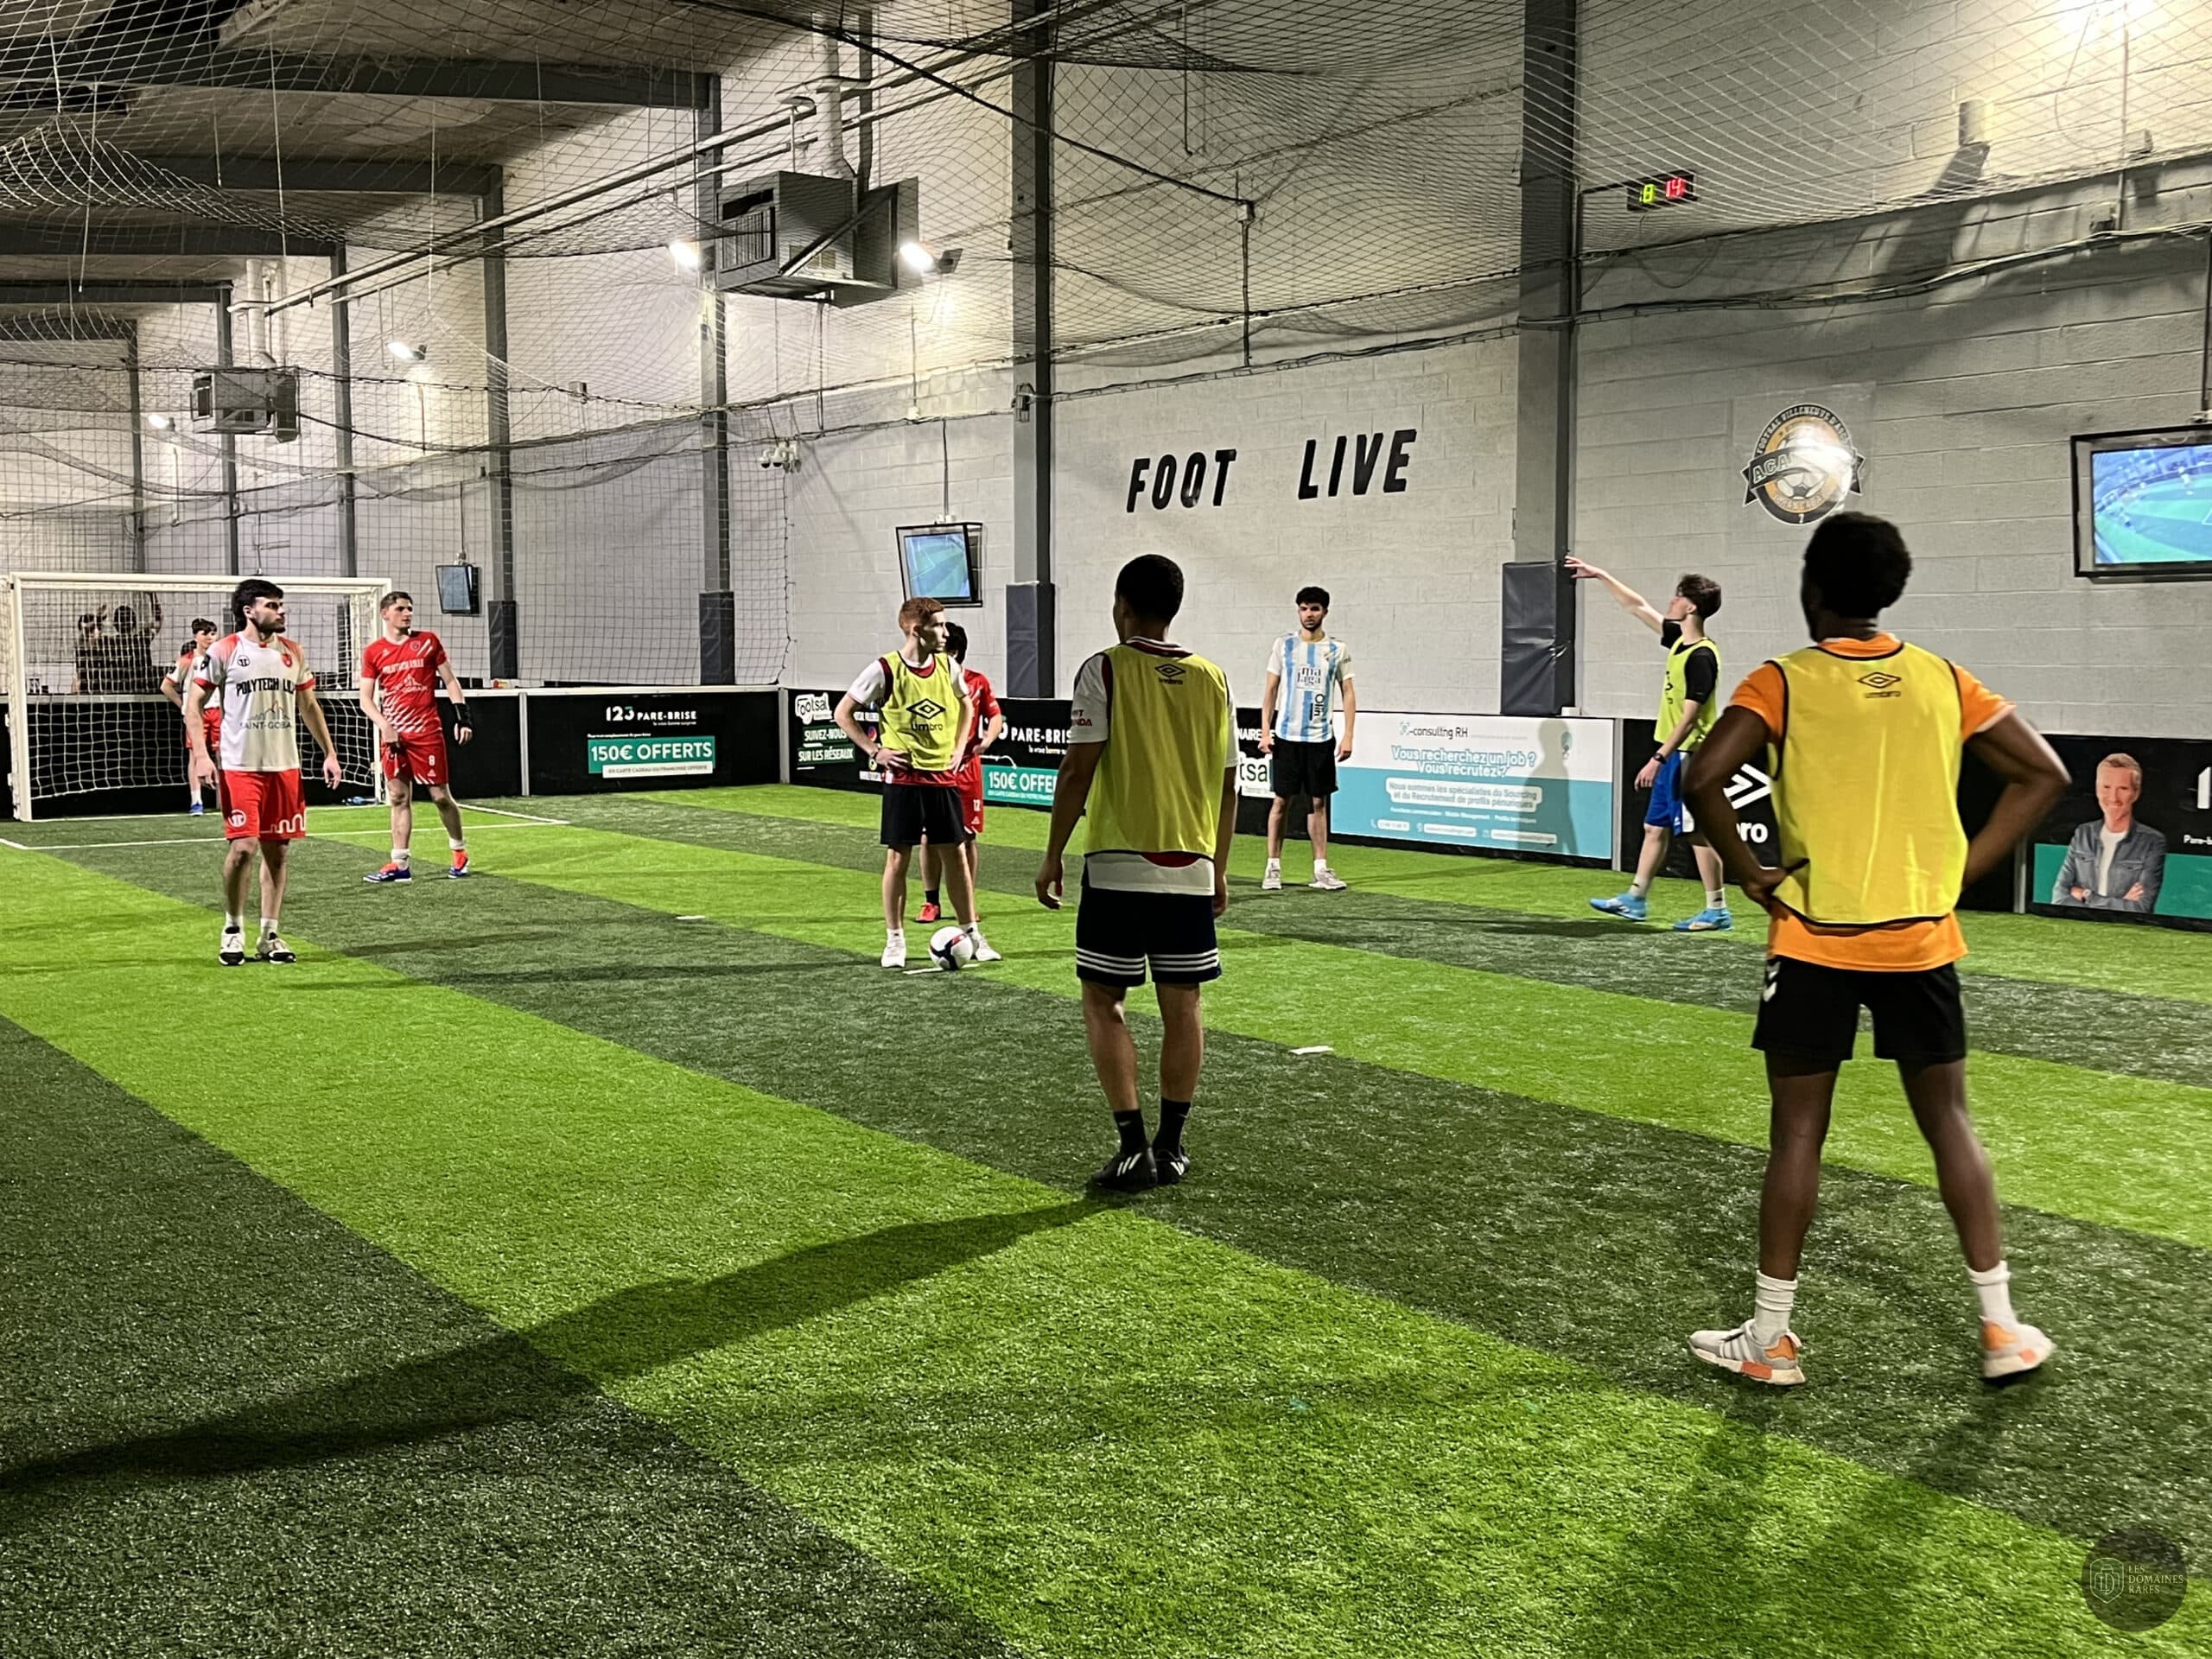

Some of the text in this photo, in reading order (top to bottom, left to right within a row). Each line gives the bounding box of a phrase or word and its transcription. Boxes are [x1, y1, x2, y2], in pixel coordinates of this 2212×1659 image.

[1127, 429, 1417, 513] FOOT LIVE
[236, 677, 279, 697] POLYTECH
[606, 706, 697, 721] 123 PARE-BRISE
[1011, 728, 1071, 744] PARE-BRIS
[1455, 727, 1468, 738] RH
[591, 741, 713, 761] 150€ OFFERTS
[798, 746, 854, 762] SUR LES RÉSEAUX
[1391, 746, 1535, 767] Vous recherchez un job ?
[429, 755, 435, 766] 8
[1418, 762, 1446, 775] Vous
[1447, 763, 1497, 777] recrutez
[988, 772, 1058, 793] 150€ OFFE
